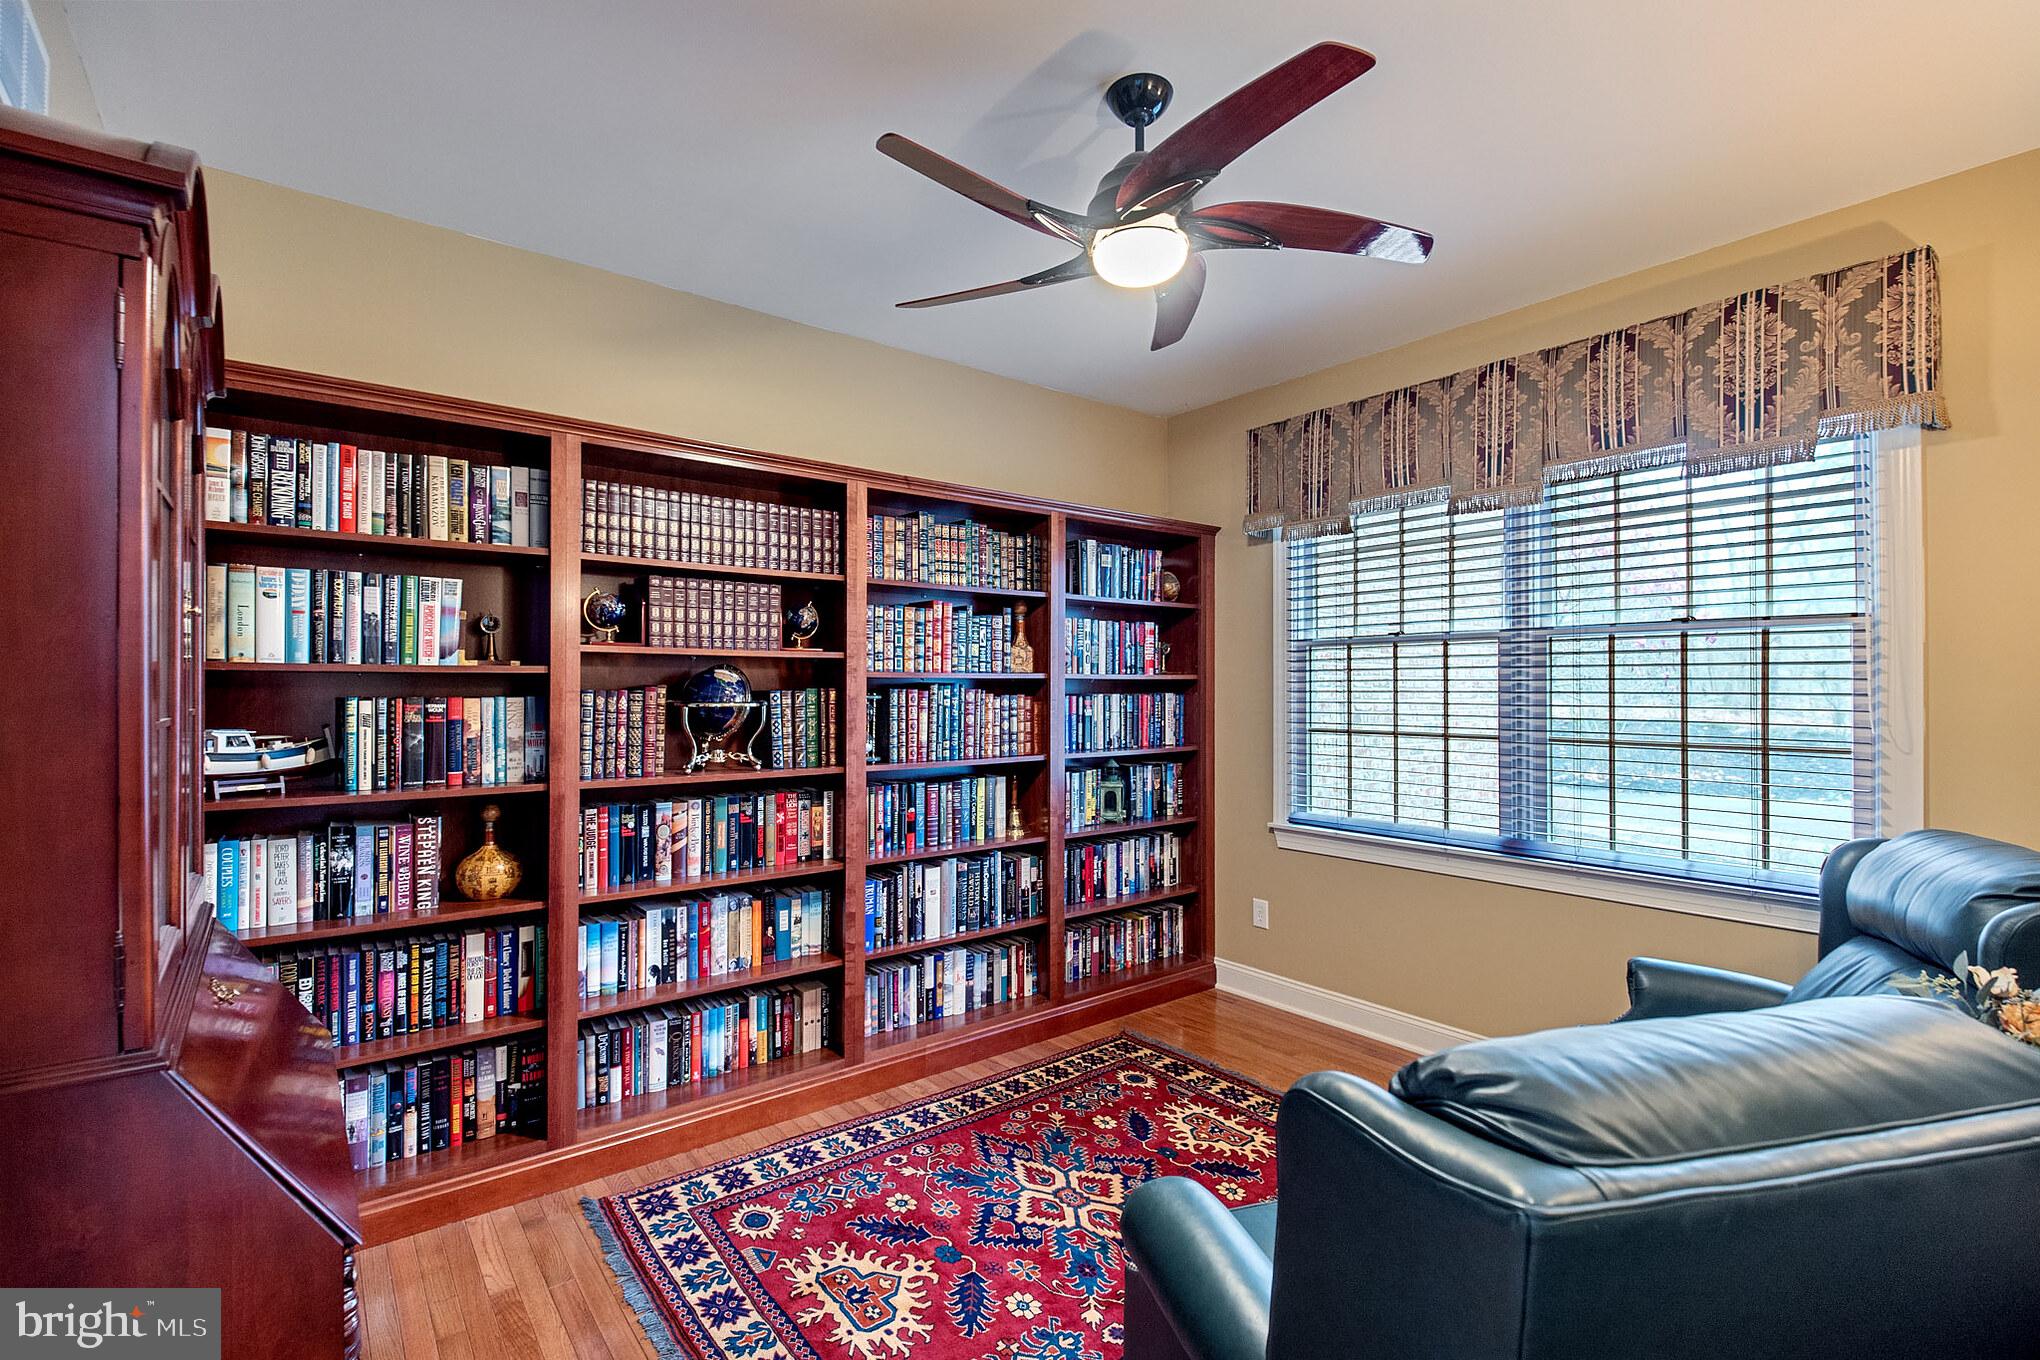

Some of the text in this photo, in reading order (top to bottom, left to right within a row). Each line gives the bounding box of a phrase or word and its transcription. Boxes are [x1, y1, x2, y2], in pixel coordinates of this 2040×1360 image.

[251, 433, 267, 479] JOHN GRISHAM
[276, 452, 290, 470] THE
[342, 466, 354, 492] THRIVING
[402, 467, 410, 494] TUROW
[450, 463, 464, 507] KEN FOLLETT
[252, 481, 264, 518] THE CHAMBER
[271, 469, 296, 520] RECKONING
[430, 475, 440, 527] KARAMAZOV
[342, 501, 353, 520] CHAOS
[472, 519, 486, 540] GAME
[389, 588, 398, 611] BATTLE
[420, 579, 430, 604] LUDLUM
[236, 603, 249, 638] London
[389, 619, 398, 643] BRITAIN
[423, 604, 435, 638] APOCALYPSE
[586, 812, 597, 826] THE
[274, 844, 290, 853] LORD
[585, 826, 597, 851] JUDGE
[688, 838, 700, 854] Prey
[221, 847, 233, 888] COUPLES
[273, 852, 291, 862] PETER
[273, 860, 291, 870] TAKES
[417, 817, 432, 910] STEPHEN KING
[274, 877, 289, 886] CASE
[276, 869, 287, 878] THE
[317, 841, 327, 904] Celestial Navigation
[395, 834, 411, 906] WINE BIBLE
[967, 878, 975, 907] WORLD
[981, 872, 989, 902] Century
[272, 896, 293, 906] SAYERS
[865, 883, 875, 916] TRUMAN
[503, 932, 512, 946] Tom
[499, 946, 512, 966] Clancy
[280, 962, 298, 985] ICON
[298, 976, 313, 991] ED
[316, 959, 326, 1006] AFTER DARK
[397, 972, 407, 989] ANGEL
[502, 967, 512, 983] Debt
[365, 977, 374, 1003] CANNELL
[397, 989, 407, 997] OF
[435, 977, 448, 1000] BLACK
[502, 989, 512, 1009] Honor
[397, 996, 407, 1016] DEATH
[424, 994, 434, 1020] SECRET
[364, 1012, 374, 1034] PLAN
[597, 1040, 609, 1065] COUNTRY
[668, 1031, 683, 1074] QUINCUNX
[478, 1074, 496, 1082] ALAMO
[624, 1065, 631, 1073] TO
[372, 1082, 385, 1115] STRAIGHT
